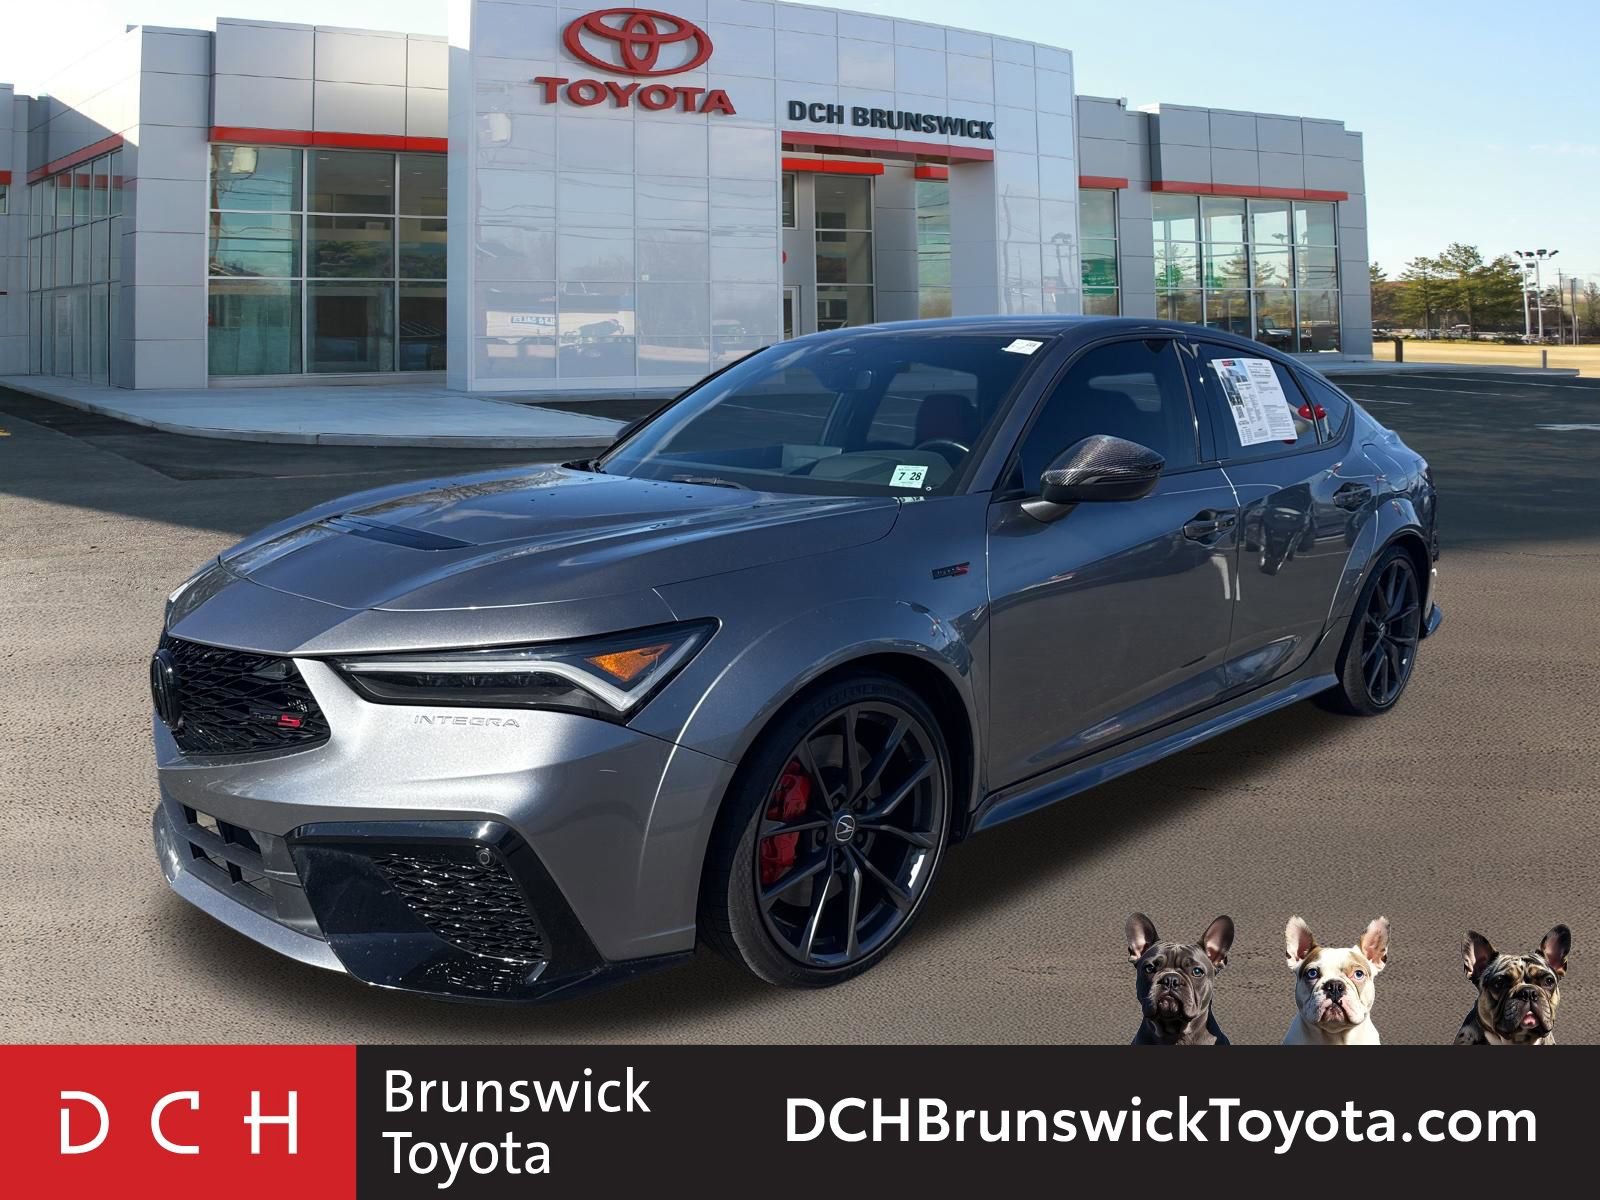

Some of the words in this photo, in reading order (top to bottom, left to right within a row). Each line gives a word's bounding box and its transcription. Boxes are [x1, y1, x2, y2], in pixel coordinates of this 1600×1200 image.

[534, 76, 736, 115] TOYOTA
[788, 100, 844, 124] DCH
[852, 106, 995, 141] BRUNSWICK
[899, 472, 906, 481] 7
[414, 715, 520, 728] INTEGRA
